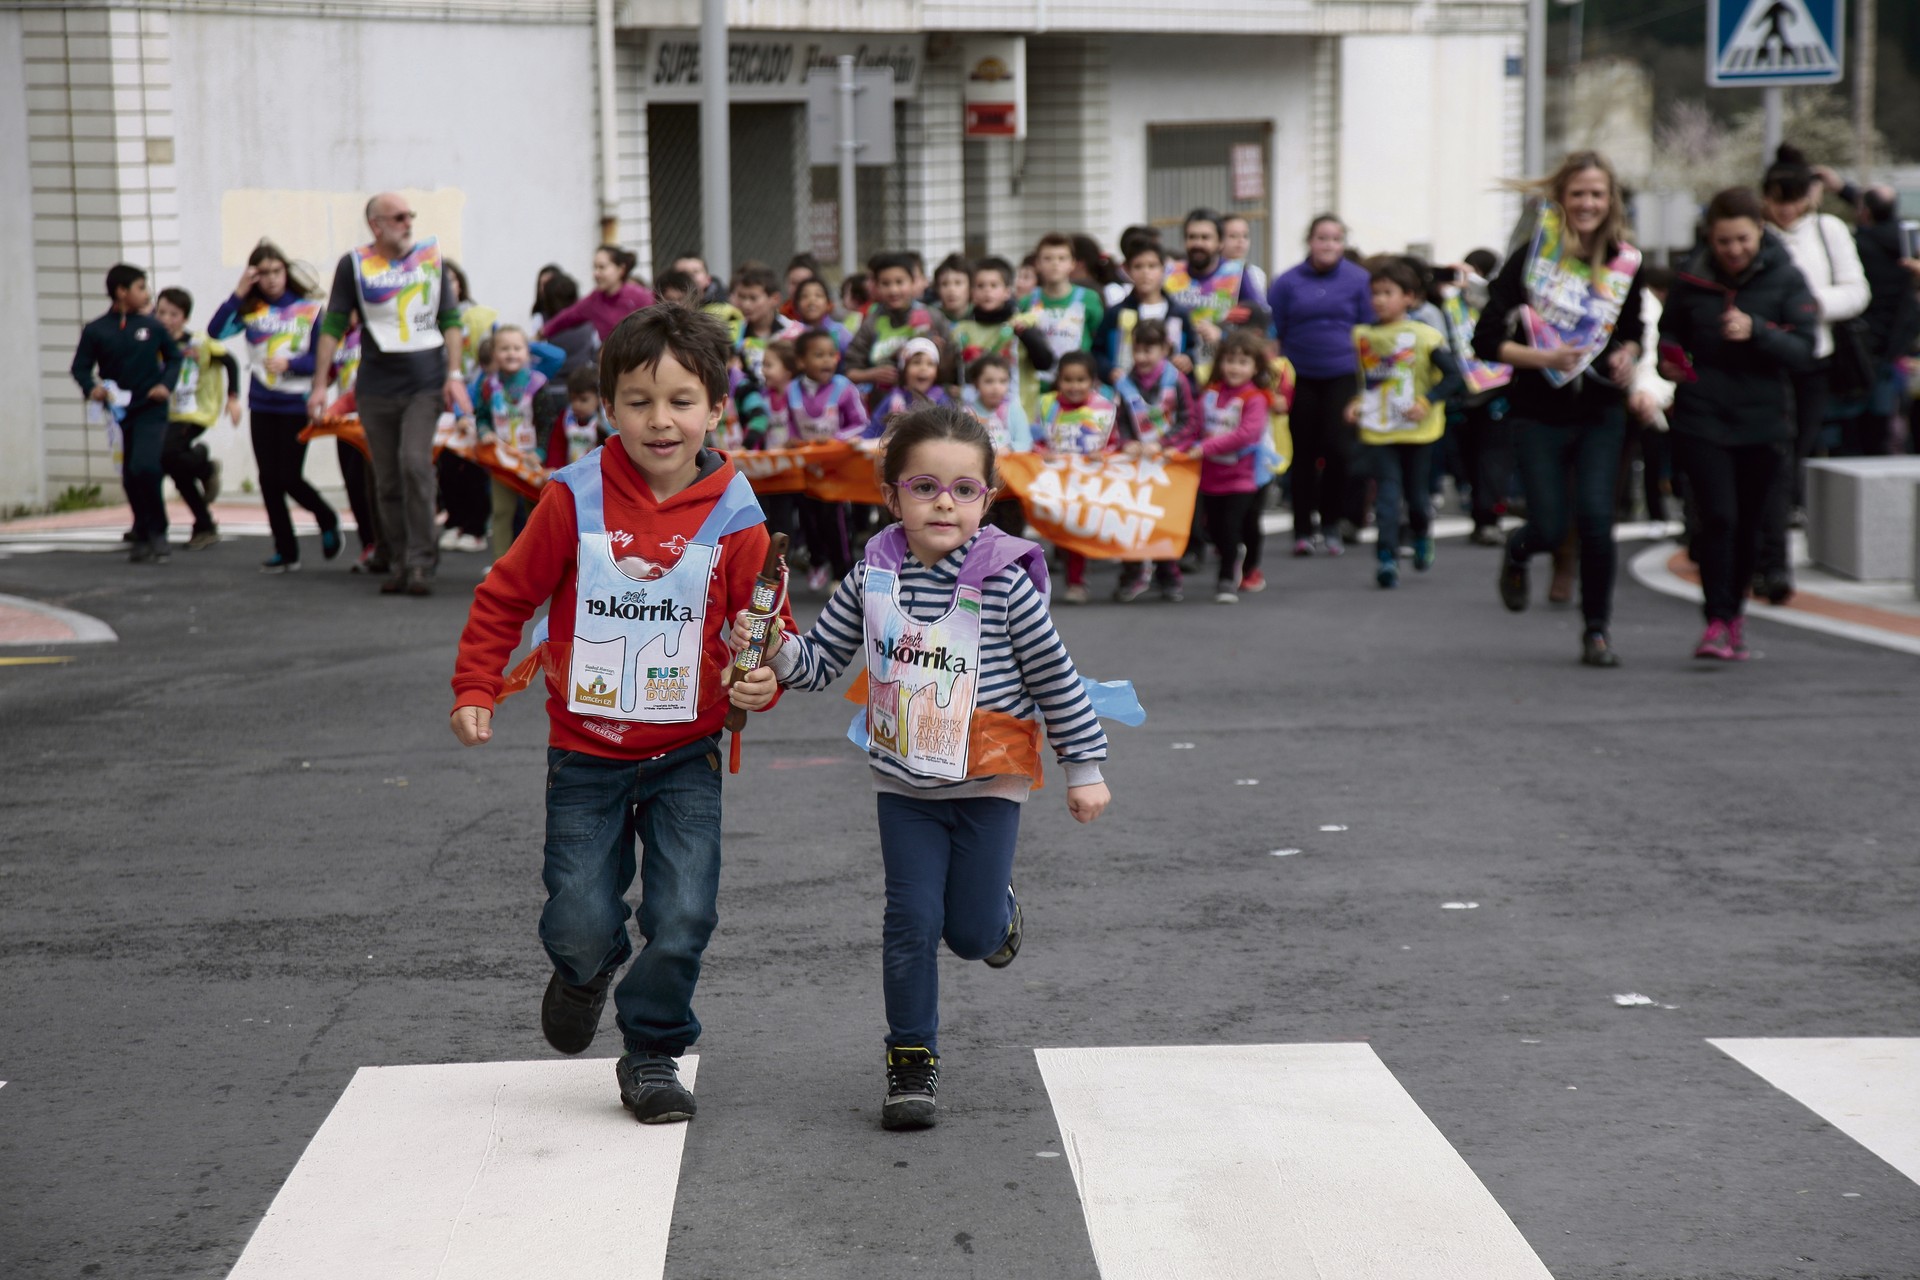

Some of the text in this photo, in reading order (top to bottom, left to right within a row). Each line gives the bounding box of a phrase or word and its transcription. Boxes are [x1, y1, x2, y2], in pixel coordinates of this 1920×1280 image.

[655, 42, 793, 83] SUPEERCADO
[1028, 470, 1166, 519] AHAL
[1033, 497, 1156, 550] DUN!
[585, 596, 694, 623] 19.korrika
[873, 637, 968, 675] 19.korrika
[646, 666, 690, 679] EUSK
[644, 678, 688, 690] AHAL
[645, 689, 687, 702] DUN!
[917, 715, 961, 732] EUSK
[914, 726, 959, 745] AHAL
[915, 737, 957, 757] DUN!
